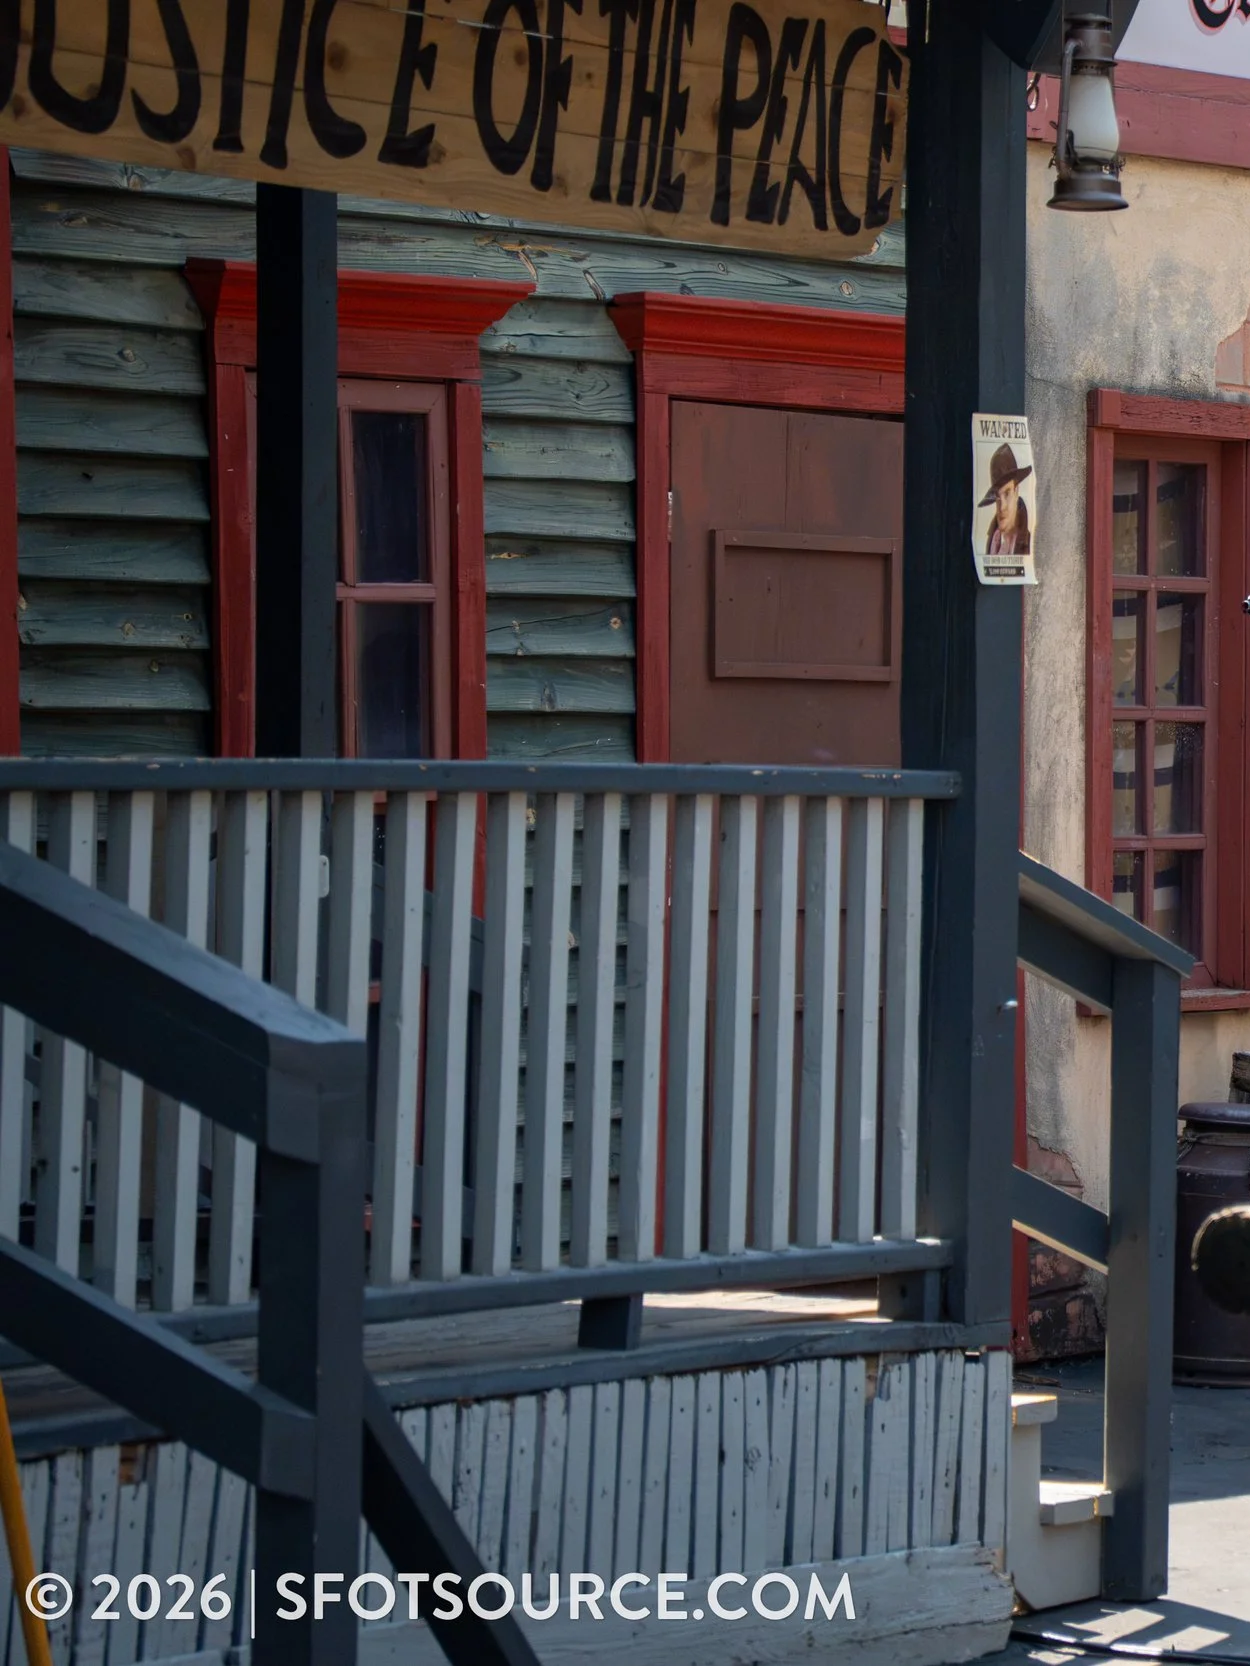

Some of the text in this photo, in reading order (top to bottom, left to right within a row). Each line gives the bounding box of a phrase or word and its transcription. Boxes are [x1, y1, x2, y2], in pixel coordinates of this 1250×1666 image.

[0, 0, 903, 236] USTICE OF THE PEACE
